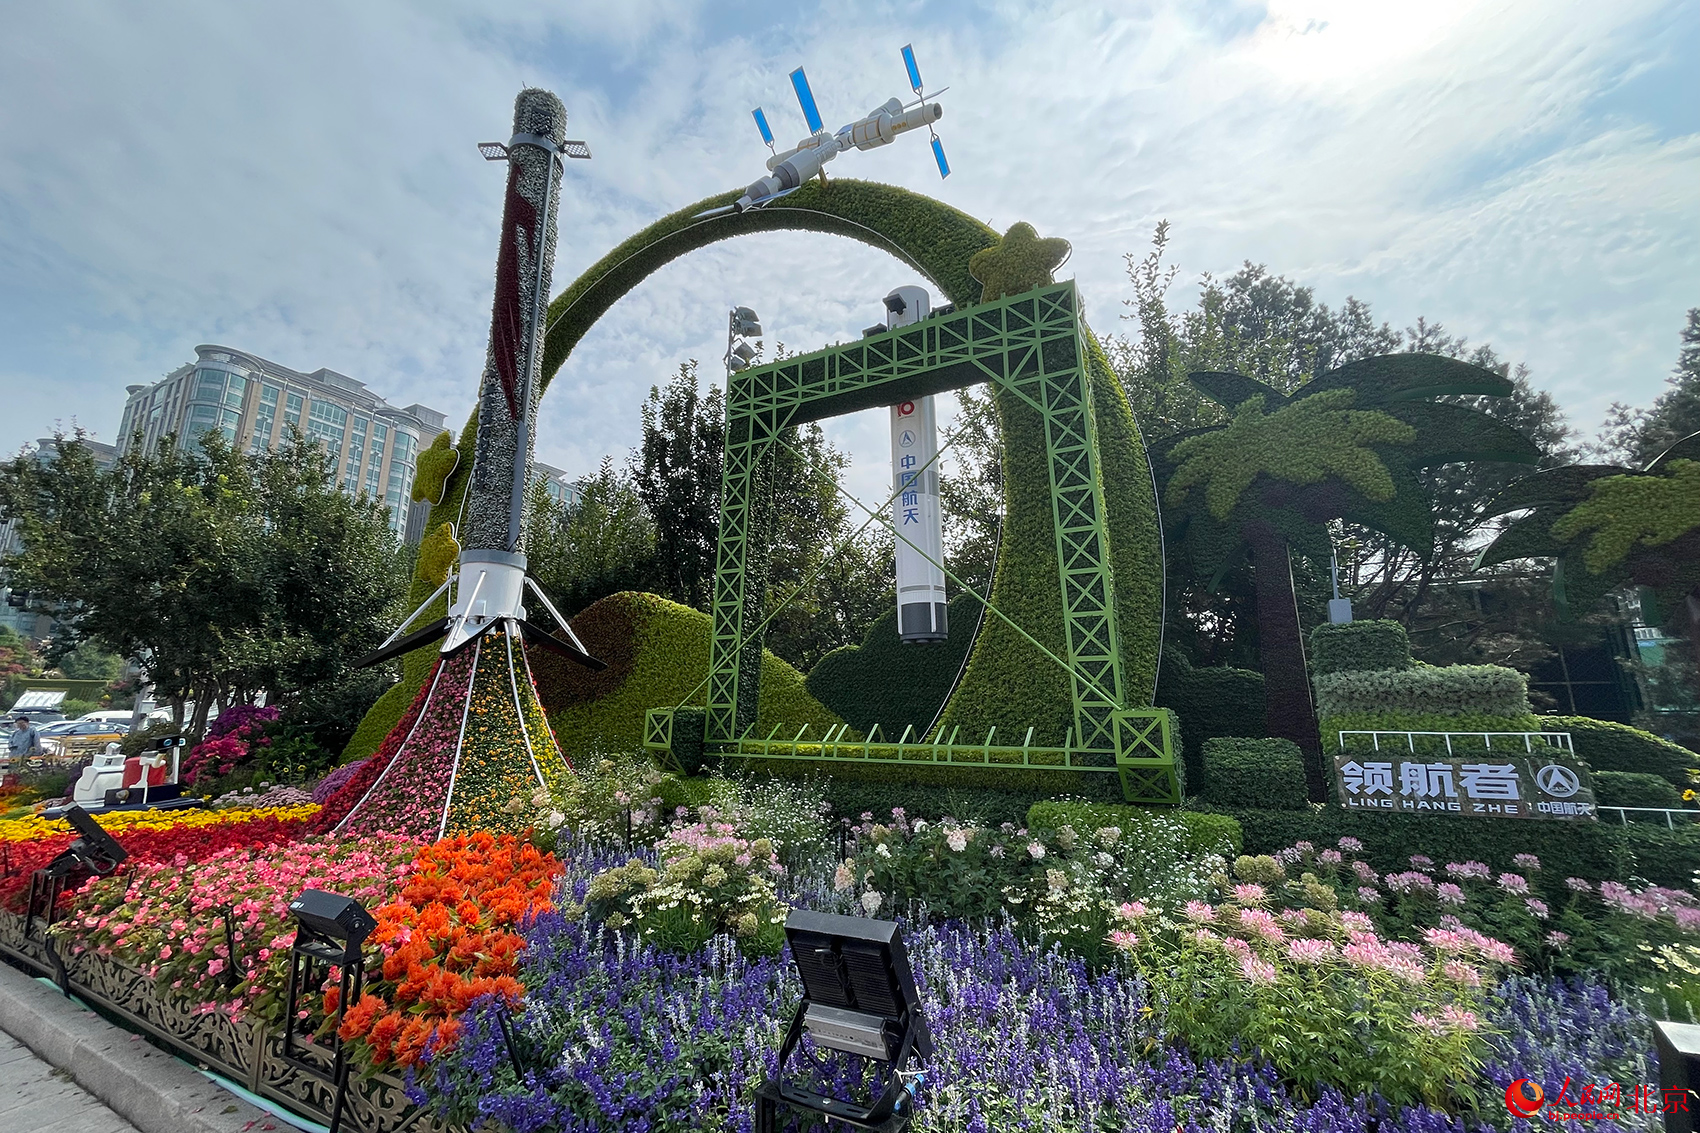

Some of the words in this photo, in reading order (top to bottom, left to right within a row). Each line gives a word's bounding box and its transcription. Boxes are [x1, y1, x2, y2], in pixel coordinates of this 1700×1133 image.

[901, 454, 919, 525] 中国航天
[1340, 760, 1520, 800] 领航者
[1348, 798, 1393, 808] LING
[1402, 800, 1462, 812] HANG
[1473, 803, 1518, 814] ZHE
[1537, 801, 1593, 815] 中国航天
